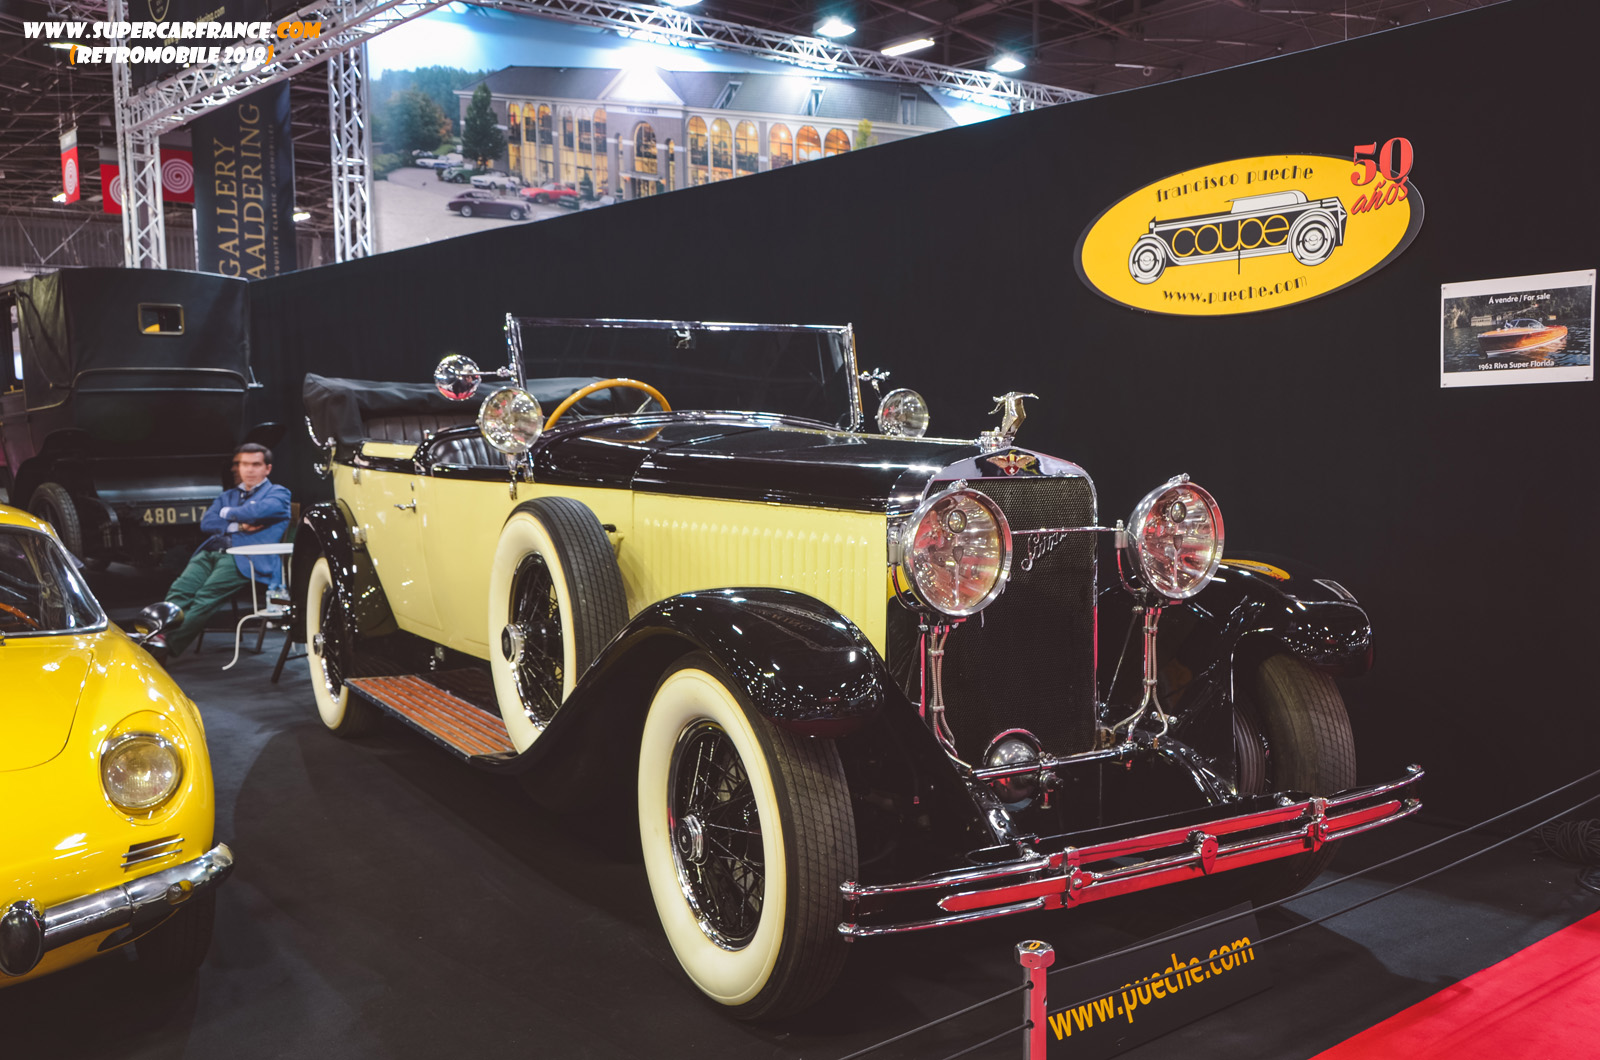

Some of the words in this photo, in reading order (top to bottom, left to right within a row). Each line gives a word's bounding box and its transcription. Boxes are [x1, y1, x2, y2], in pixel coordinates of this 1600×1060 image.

[1350, 137, 1414, 187] 50
[239, 104, 266, 280] AALDERING
[1156, 173, 1239, 202] francisco
[1246, 165, 1314, 185] pueche
[1350, 175, 1409, 216] años
[213, 137, 241, 277] GALLERY
[1163, 275, 1308, 304] www.pueche.com
[1523, 293, 1536, 301] For
[1536, 292, 1551, 300] sale
[1494, 361, 1509, 369] Riva
[1509, 361, 1530, 369] Super
[1530, 360, 1555, 368] Florida
[1047, 936, 1256, 1041] www.pueche.com
